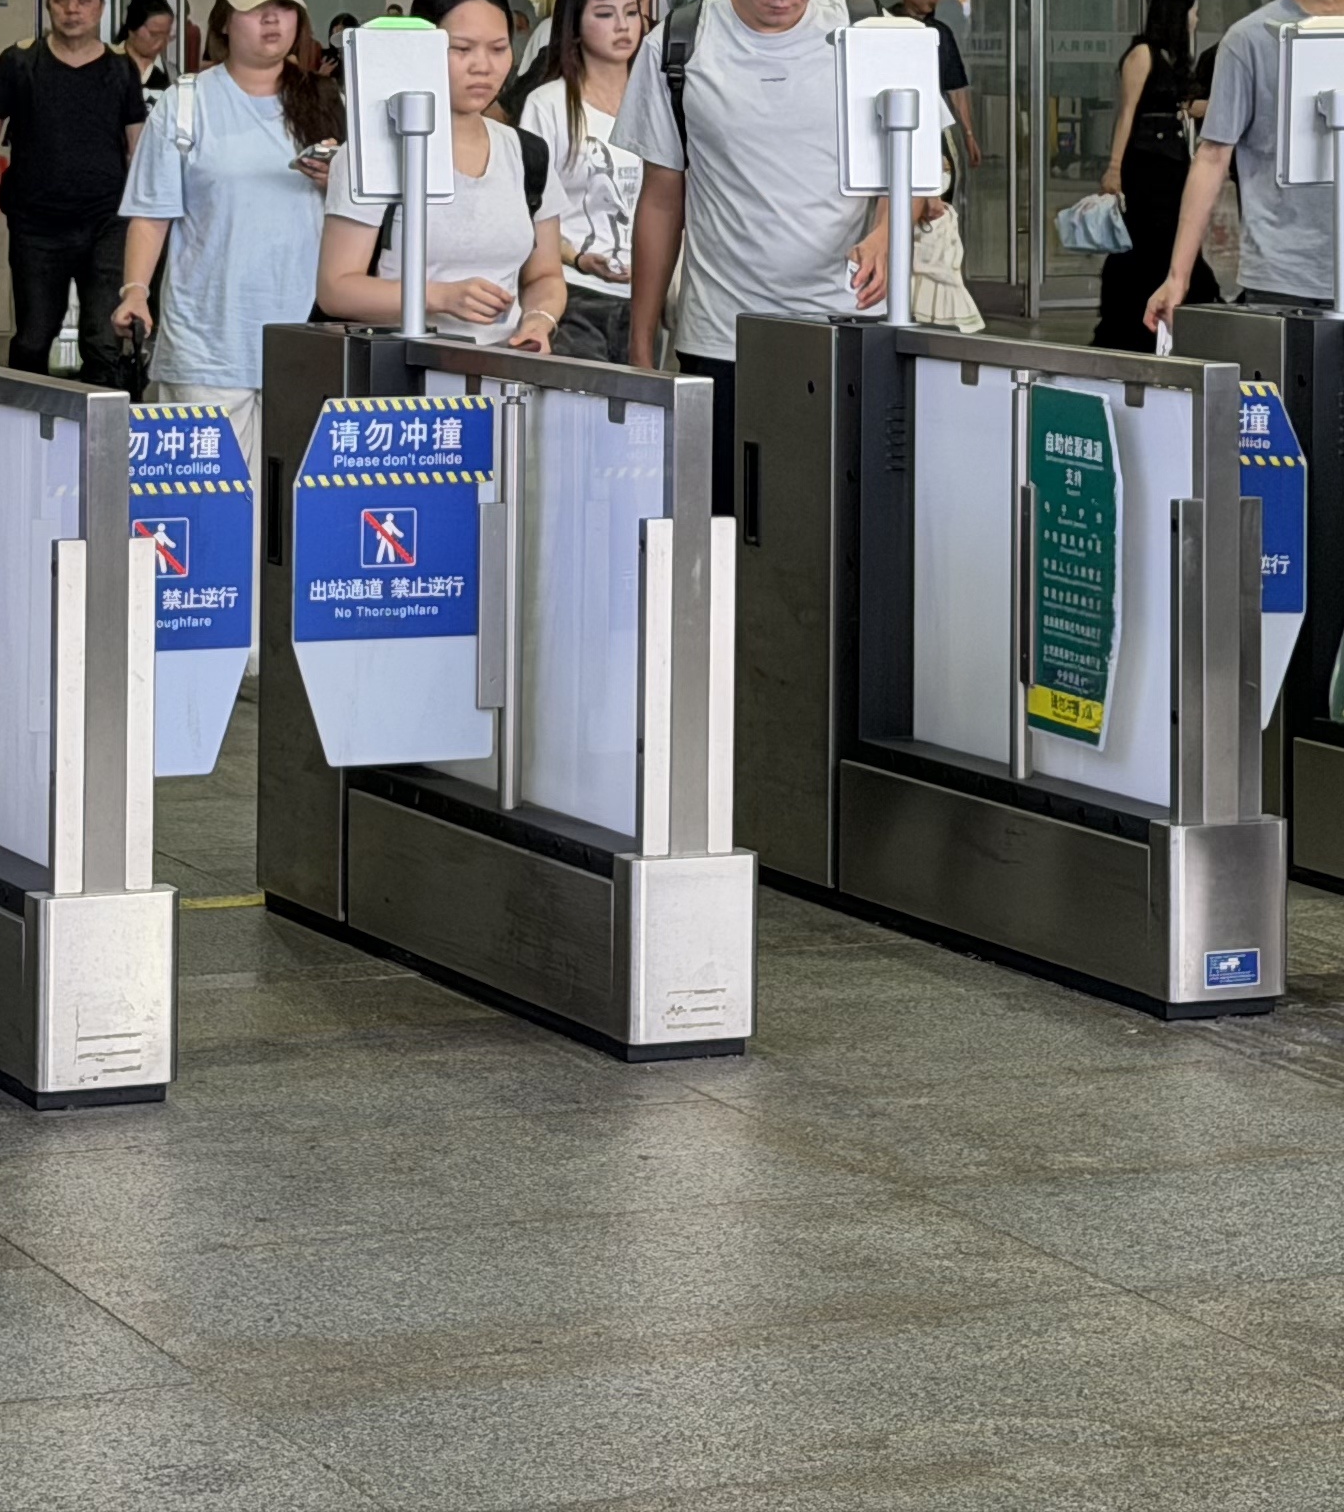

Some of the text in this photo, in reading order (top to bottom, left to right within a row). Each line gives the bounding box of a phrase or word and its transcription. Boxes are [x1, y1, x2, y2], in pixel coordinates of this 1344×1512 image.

[329, 417, 462, 452] 请勿冲撞
[139, 463, 172, 476] don't
[176, 462, 220, 474] collide
[334, 453, 462, 467] Please don't collide
[310, 576, 464, 601] 出站通道 禁止逆行
[163, 587, 238, 610] 禁止逆行
[335, 605, 438, 618] No Thoroughfare
